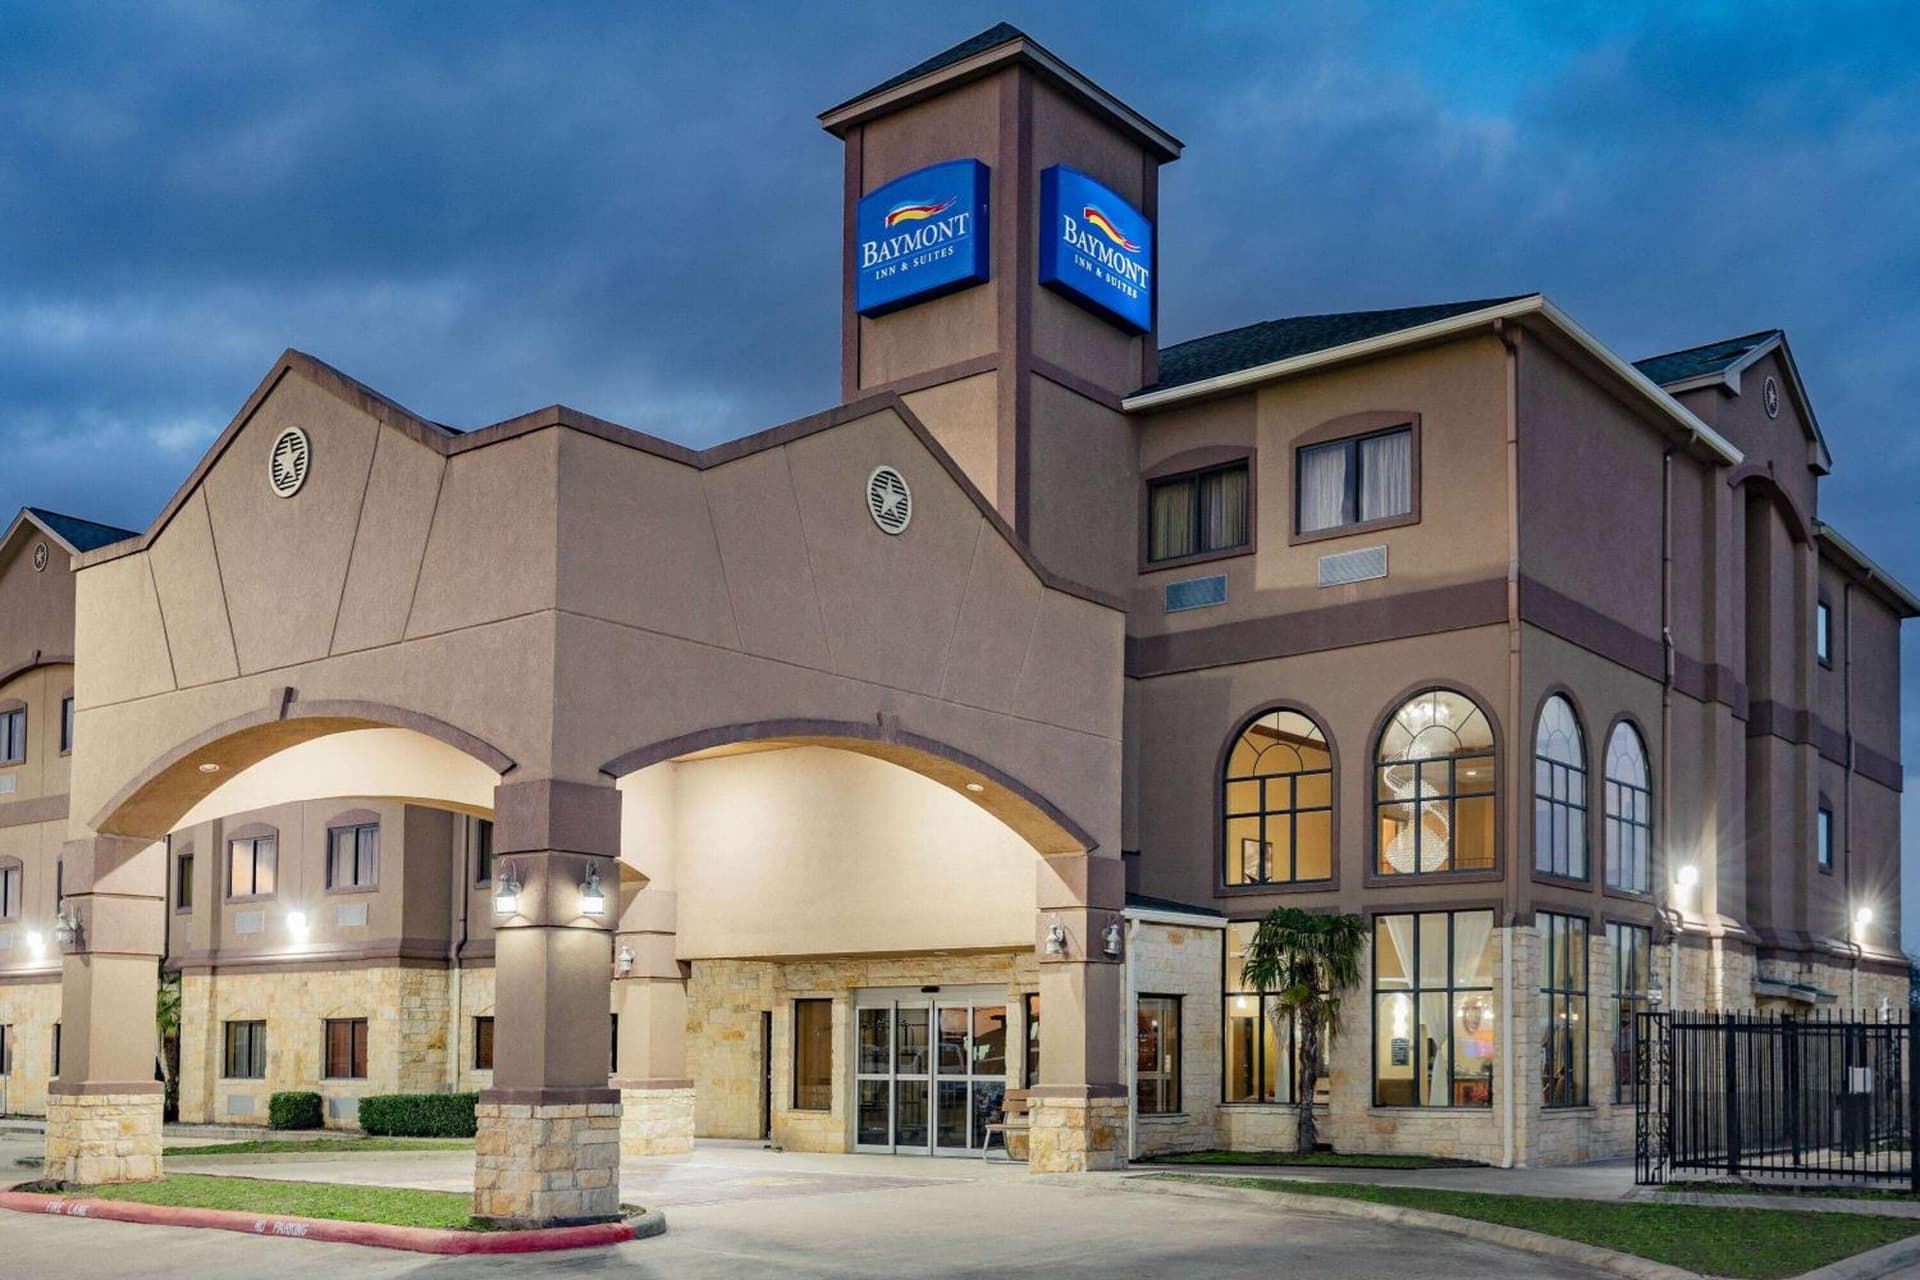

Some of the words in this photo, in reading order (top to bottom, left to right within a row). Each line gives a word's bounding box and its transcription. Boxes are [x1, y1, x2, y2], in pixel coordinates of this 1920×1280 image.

[862, 212, 969, 268] BAYMONT
[875, 264, 896, 280] INN
[900, 261, 909, 272] &
[913, 245, 954, 268] SUITES
[1063, 214, 1149, 288] BAYMONT
[1074, 253, 1093, 272] INN
[1095, 268, 1102, 278] &
[1105, 274, 1138, 299] SUITES
